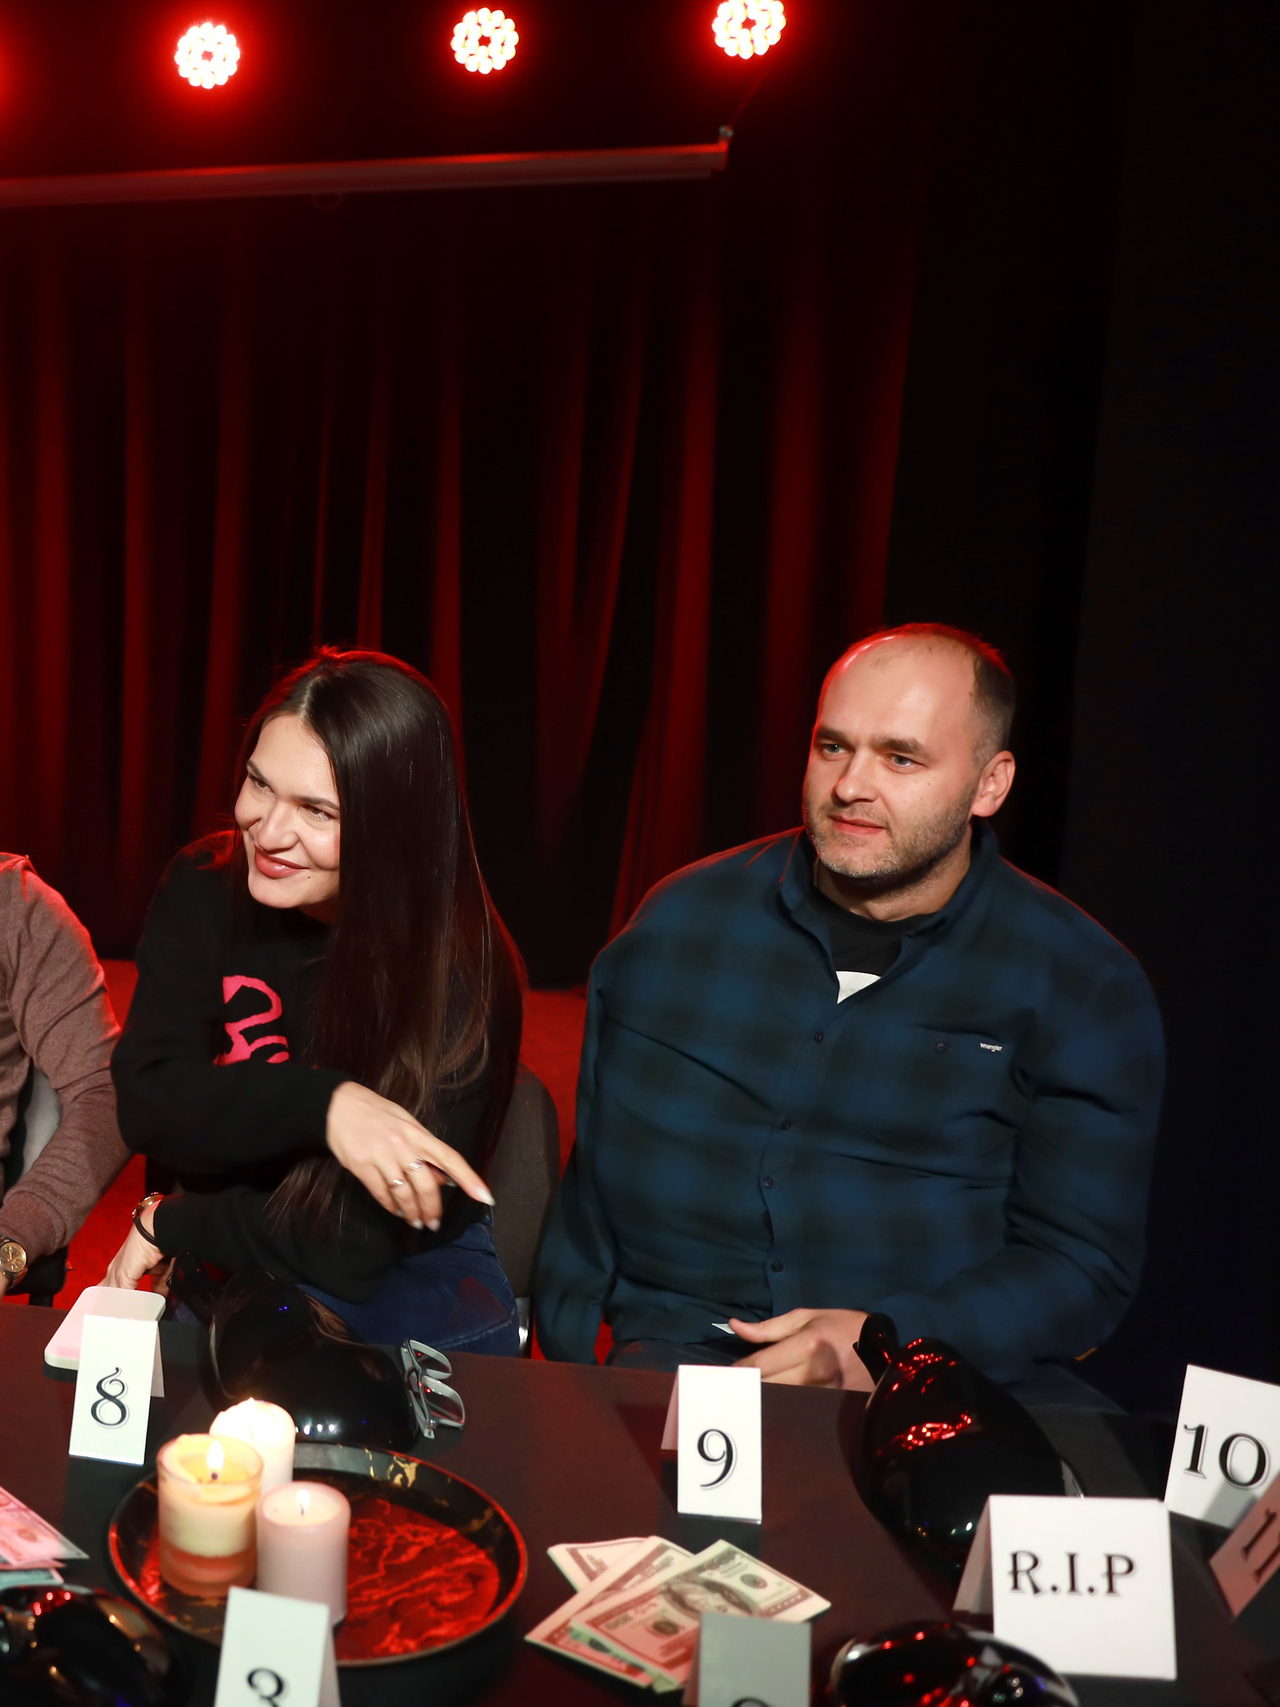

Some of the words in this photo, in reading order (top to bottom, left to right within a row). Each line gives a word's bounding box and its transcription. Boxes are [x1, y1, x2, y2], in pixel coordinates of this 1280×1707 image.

[90, 1366, 130, 1429] 8
[696, 1428, 738, 1490] 9
[1183, 1423, 1271, 1489] 10
[1008, 1550, 1136, 1597] R.I.P
